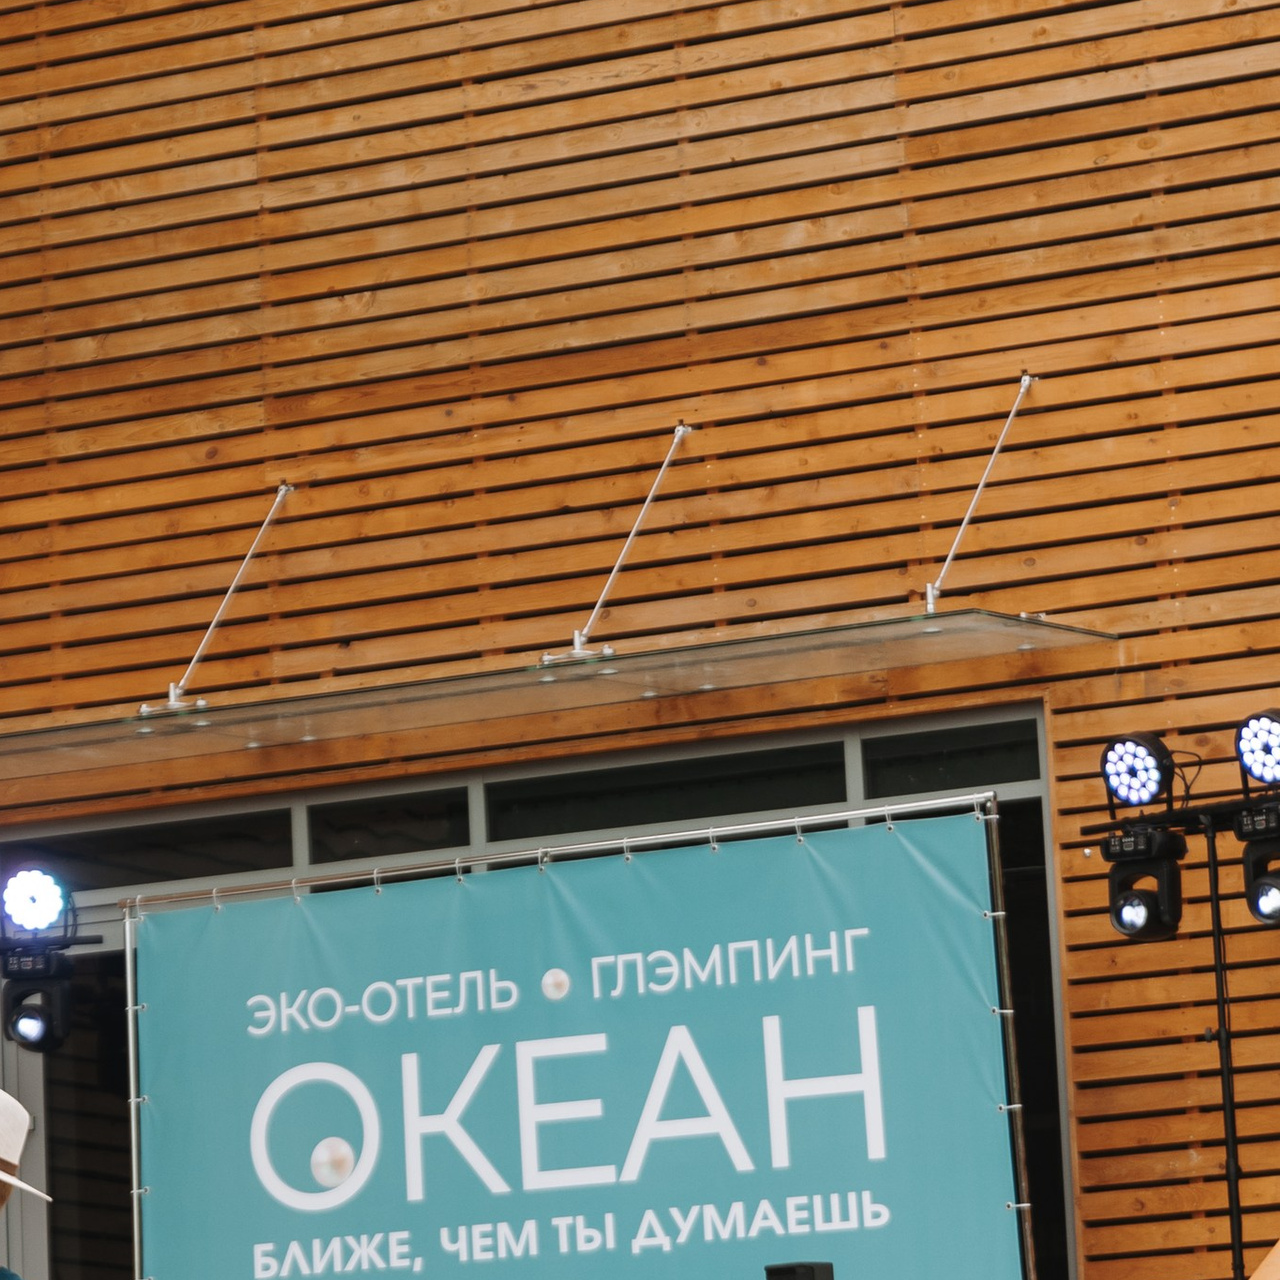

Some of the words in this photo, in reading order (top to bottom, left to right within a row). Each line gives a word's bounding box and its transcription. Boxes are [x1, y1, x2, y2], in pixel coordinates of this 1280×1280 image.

[246, 968, 519, 1037] ЭКО-ОТЕЛЬ
[591, 927, 871, 999] ГЛЭМПИНГ
[249, 1005, 887, 1212] ОКЕАН
[252, 1230, 424, 1280] БЛИЖЕ,
[439, 1219, 538, 1263] ЧЕМ
[551, 1212, 616, 1255] ТЫ
[631, 1190, 891, 1255] ДУМАЕШЬ
